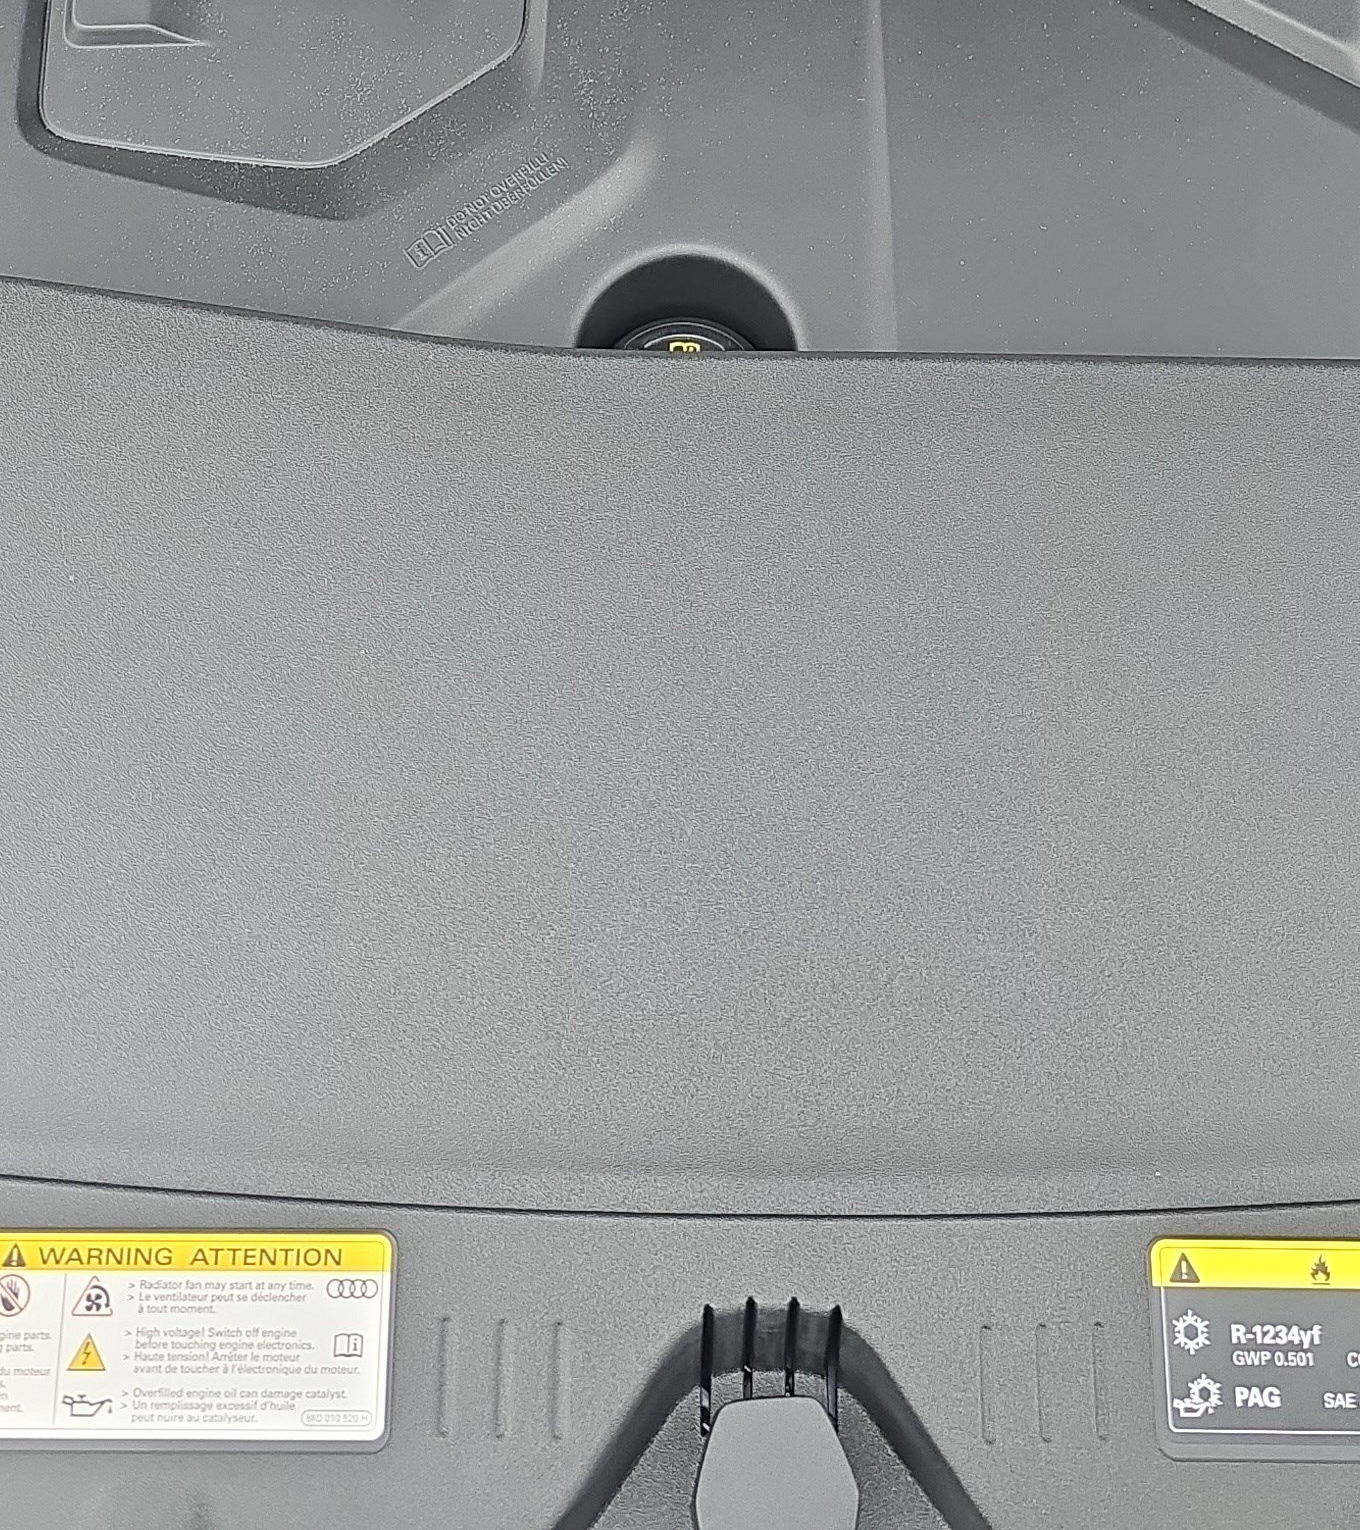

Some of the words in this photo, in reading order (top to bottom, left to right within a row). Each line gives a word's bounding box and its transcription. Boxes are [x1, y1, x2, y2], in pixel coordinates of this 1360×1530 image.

[446, 210, 467, 230] DO
[465, 194, 491, 215] NOT
[39, 1247, 174, 1267] WARNING
[190, 1247, 343, 1267] ATTENTION
[139, 1280, 183, 1290] Radiator
[185, 1280, 202, 1290] fan
[204, 1282, 227, 1292] may
[229, 1280, 253, 1290] start
[255, 1281, 265, 1290] at
[267, 1282, 286, 1293] any
[289, 1280, 315, 1290] time.
[138, 1292, 152, 1302] Le
[153, 1292, 208, 1302] ventilateur
[210, 1293, 234, 1303] peut
[236, 1294, 248, 1303] se
[250, 1292, 306, 1303] déclencher
[138, 1304, 144, 1314] à
[146, 1304, 167, 1314] tout
[136, 1327, 160, 1340] High
[207, 1327, 242, 1338] Switch
[245, 1327, 260, 1338] off
[261, 1328, 296, 1340] engine
[1230, 1324, 1322, 1349] R-1234yf
[171, 1340, 216, 1352] touching
[219, 1340, 254, 1352] engine
[257, 1340, 315, 1351] electronics.
[134, 1352, 164, 1362] Haute
[250, 1352, 260, 1362] le
[262, 1353, 301, 1362] moteur
[1232, 1351, 1270, 1367] GWP
[1274, 1351, 1315, 1367] 0.501
[13, 1367, 51, 1376] moteur
[133, 1365, 162, 1374] avant
[164, 1364, 178, 1374] de
[180, 1364, 220, 1374] toucher
[222, 1364, 229, 1374] à
[304, 1365, 318, 1375] du
[320, 1366, 361, 1375] moteur.
[133, 1388, 183, 1399] Overfilled
[186, 1389, 221, 1401] engine
[223, 1388, 237, 1399] oil
[239, 1390, 258, 1399] can
[260, 1389, 302, 1401] damage
[1234, 1386, 1282, 1408] PAG
[132, 1400, 148, 1411] Un
[150, 1400, 213, 1412] remplissage
[216, 1400, 258, 1411] excessif
[1323, 1393, 1357, 1410] SAE
[131, 1414, 154, 1424] peut
[157, 1413, 184, 1423] nuire
[187, 1415, 200, 1423] au
